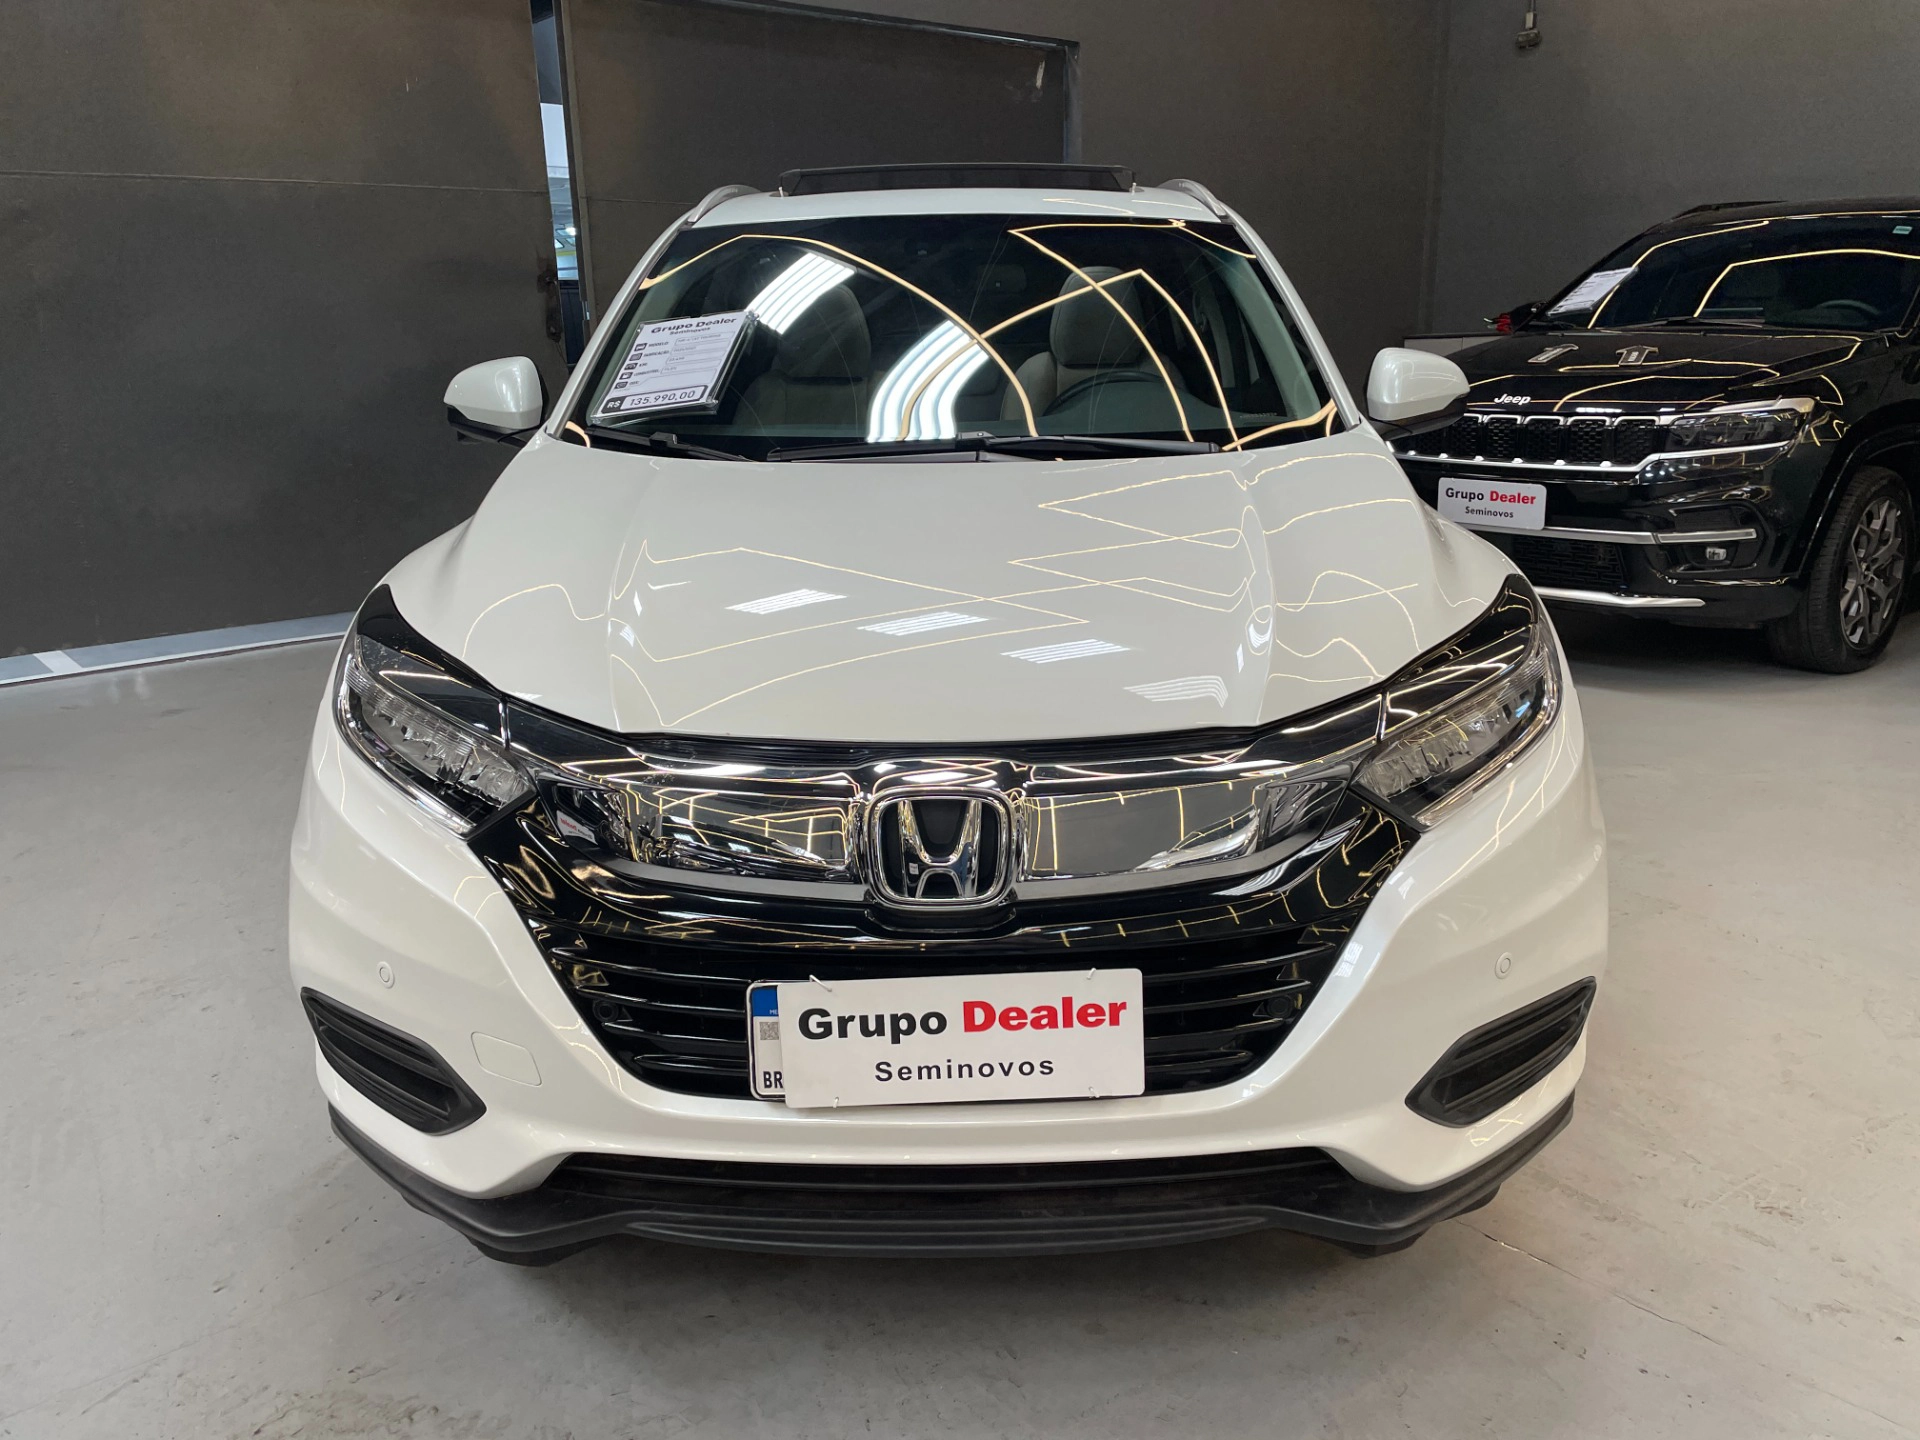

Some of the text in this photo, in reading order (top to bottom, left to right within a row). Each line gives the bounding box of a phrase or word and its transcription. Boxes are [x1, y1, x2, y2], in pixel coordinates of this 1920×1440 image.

[651, 318, 737, 334] Grupo Dealer
[1494, 393, 1532, 405] Jeep
[1445, 488, 1537, 505] Grupo Dealer
[1465, 506, 1514, 518] Seminovos
[798, 996, 1128, 1044] Grupo Dealer
[874, 1059, 1056, 1082] Seminovos
[763, 1070, 783, 1089] BR
